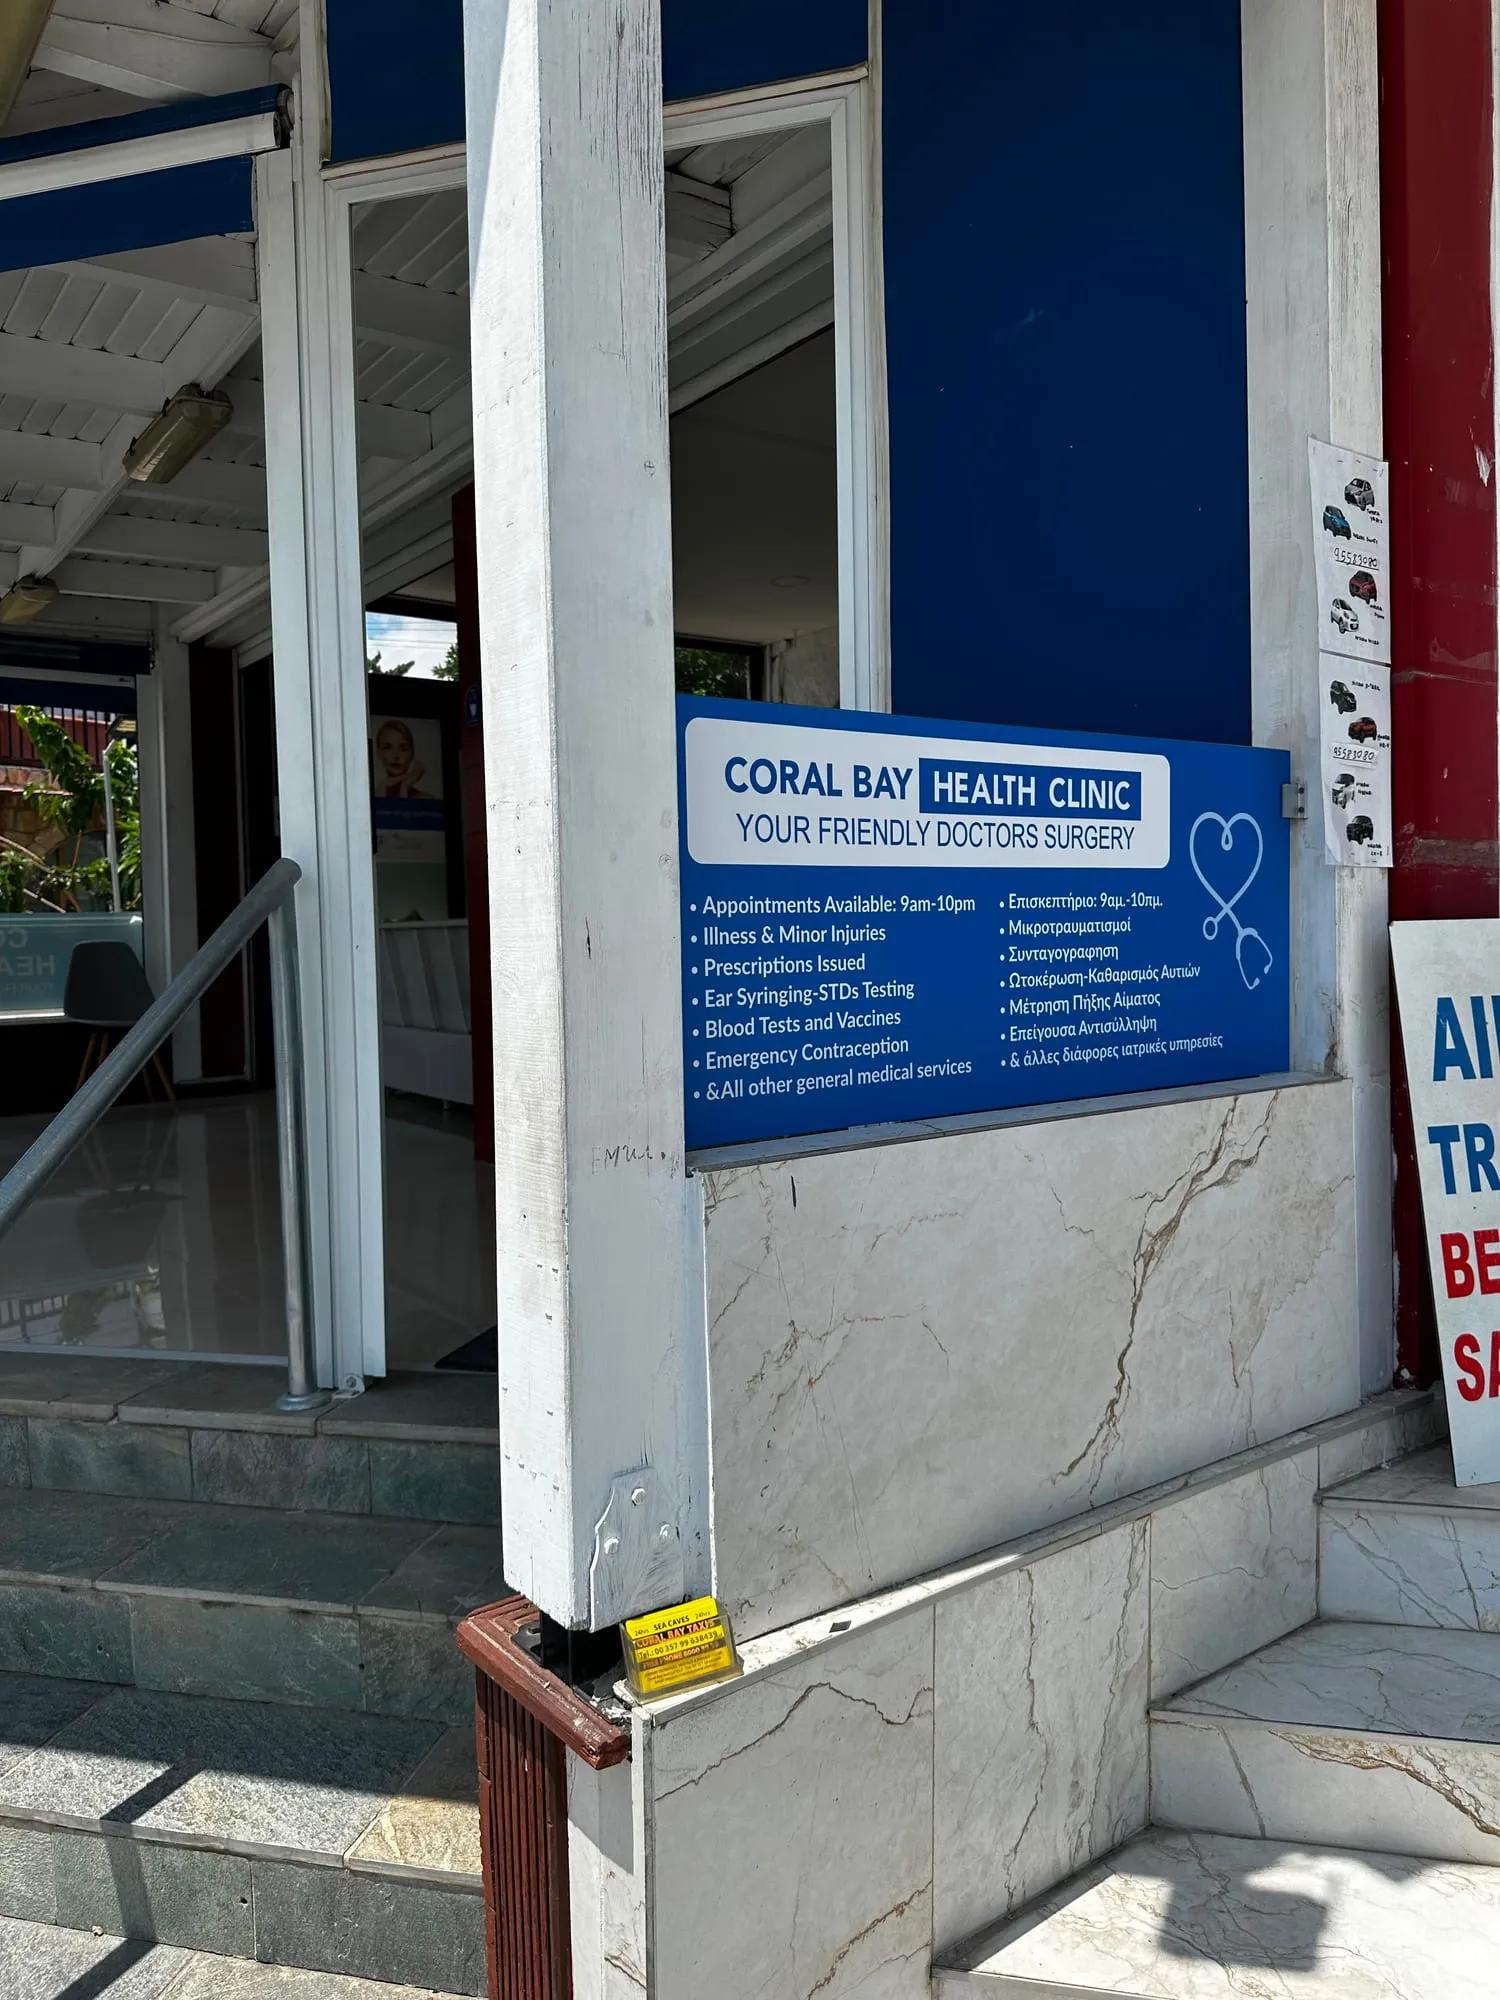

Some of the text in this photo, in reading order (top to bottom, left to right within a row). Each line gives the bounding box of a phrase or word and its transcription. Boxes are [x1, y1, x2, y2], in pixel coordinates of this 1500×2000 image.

[725, 756, 1130, 810] CORAL BAY HEALTH CLINIC
[736, 813, 1135, 850] YOUR FRIENDLY DOCTORS SURGERY
[703, 895, 976, 918] Appointments Available: 9am-10pm
[1008, 892, 1163, 911] Επισκεπτήριο: 9αμ.-10πμ.
[703, 924, 886, 945] Illness & Minor Injuries
[1008, 917, 1131, 937] Μικροτραυματισμοί
[704, 953, 866, 978] Prescriptions Issued
[1008, 944, 1119, 963] Συνταγογραφηση
[1009, 963, 1201, 988] Ωτοκέρωση-Καθαρισμός Αυτιών
[705, 979, 915, 1008] Ear Syringing-STDs Testing
[1010, 991, 1161, 1017] Μέτρηση Πήξης Αίματος
[705, 1009, 901, 1039] Blood Tests and Vaccines
[1010, 1015, 1157, 1042] Επείγουσα Αντισύλληψη
[706, 1037, 909, 1071] Emergency Contraception
[1010, 1032, 1223, 1067] & άλλες διάφορες ιατρικές υπηρεσίες
[706, 1059, 972, 1101] &All other general medical services
[653, 1622, 667, 1631] SEA
[668, 1615, 690, 1627] CAVES
[695, 1611, 711, 1620] 24hrs
[665, 1642, 679, 1652] 357
[680, 1639, 689, 1648] 99
[667, 1628, 686, 1640] BAY
